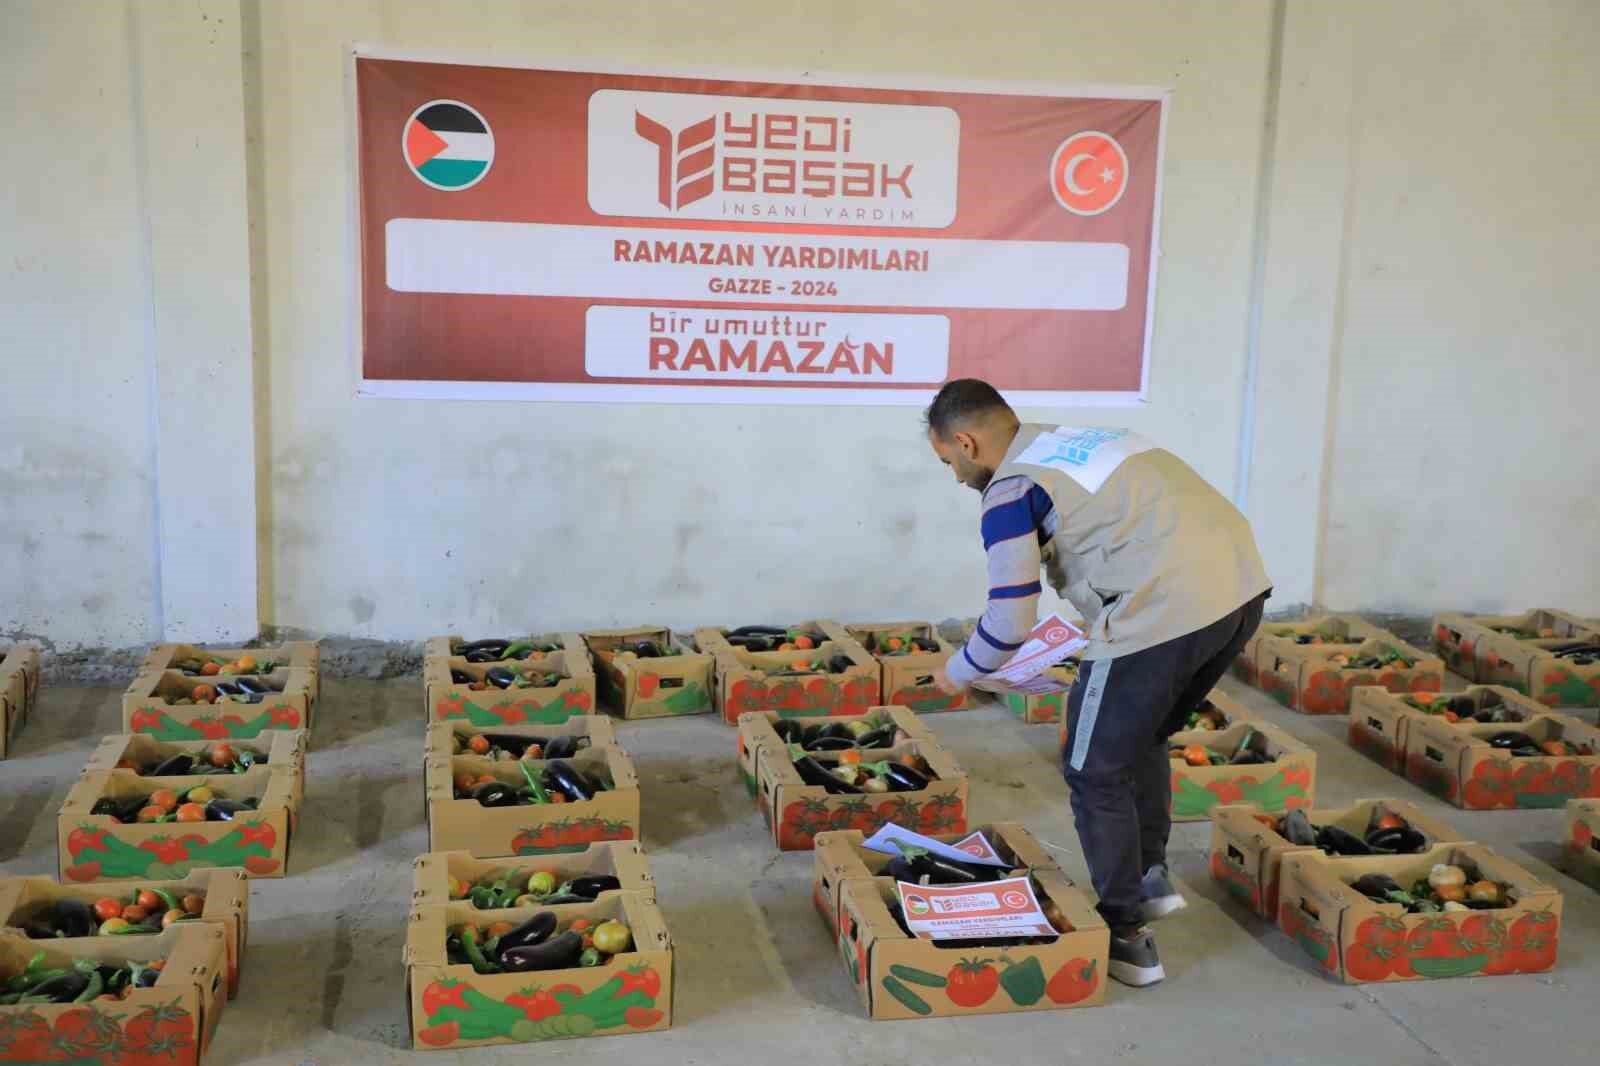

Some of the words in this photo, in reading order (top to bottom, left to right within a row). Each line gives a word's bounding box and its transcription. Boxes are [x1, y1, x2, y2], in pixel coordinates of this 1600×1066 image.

[824, 207, 915, 221] YARDIM
[614, 239, 754, 266] RAMAZAN
[763, 245, 929, 271] YARDIMLARI
[708, 277, 772, 295] GAZZE
[791, 280, 838, 296] 2024
[649, 311, 693, 333] bir
[704, 315, 828, 337] umuttur
[649, 336, 894, 375] RAMAZAN
